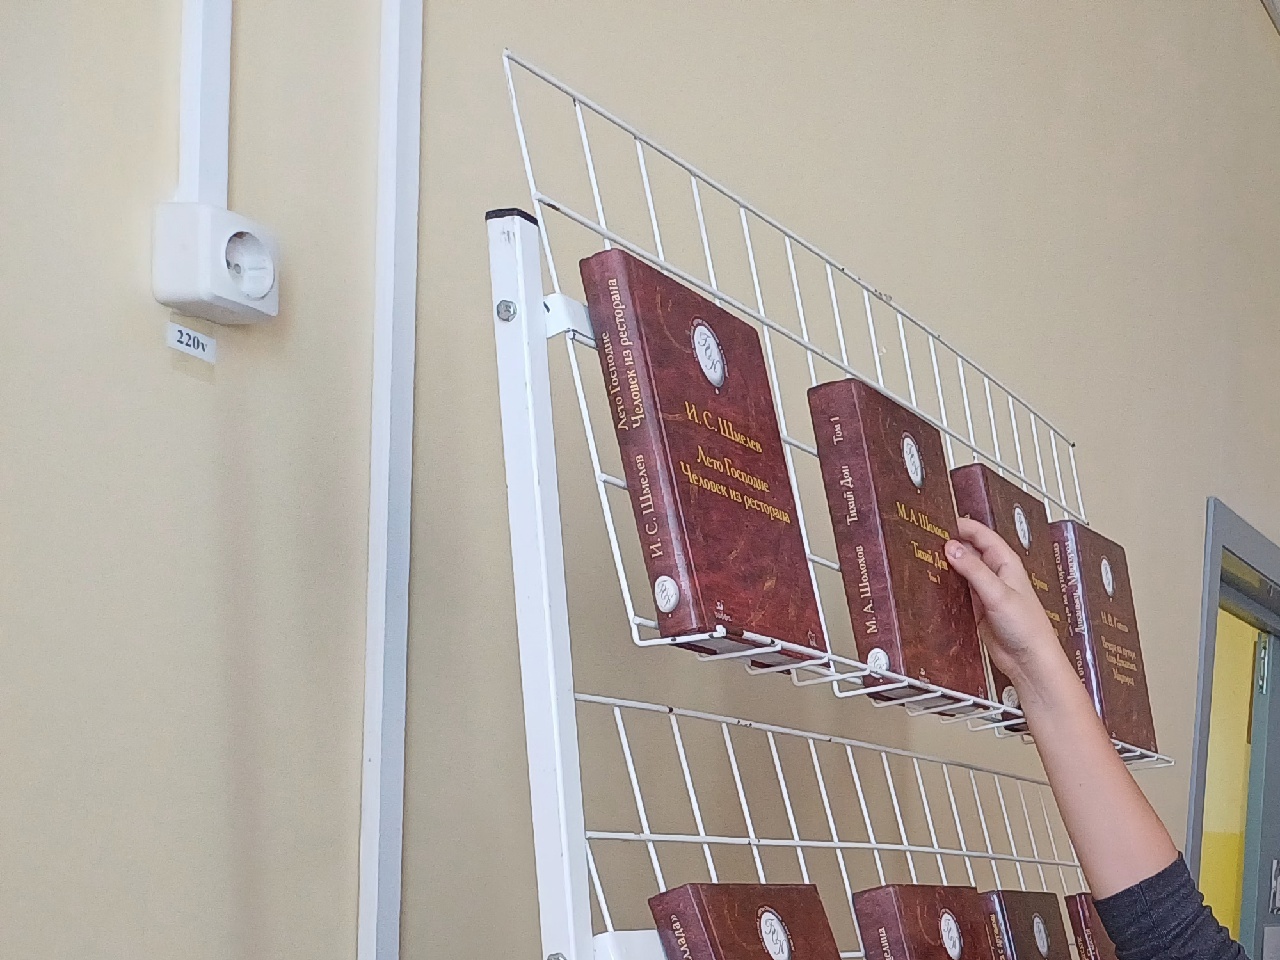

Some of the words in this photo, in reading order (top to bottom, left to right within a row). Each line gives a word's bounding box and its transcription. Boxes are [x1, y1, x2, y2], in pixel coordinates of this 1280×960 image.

[607, 278, 634, 346] ресторана
[602, 331, 621, 394] Господне
[623, 350, 635, 366] из
[616, 396, 629, 431] Лето
[627, 370, 645, 429] Человек
[684, 401, 702, 425] И.
[702, 410, 718, 432] С.
[717, 416, 763, 453] Шмелев
[832, 423, 844, 446] Том
[635, 454, 655, 515] Шмелев
[696, 445, 724, 473] Лето
[723, 457, 770, 493] Господне
[840, 465, 854, 489] Дон
[679, 461, 728, 498] Человек
[729, 489, 742, 503] из
[743, 494, 791, 524] ресторана
[842, 491, 858, 526] Тихий
[645, 517, 658, 535] С.
[650, 538, 663, 559] И.
[855, 545, 872, 599] Шолохов
[862, 600, 875, 614] А.
[864, 613, 878, 634] М.
